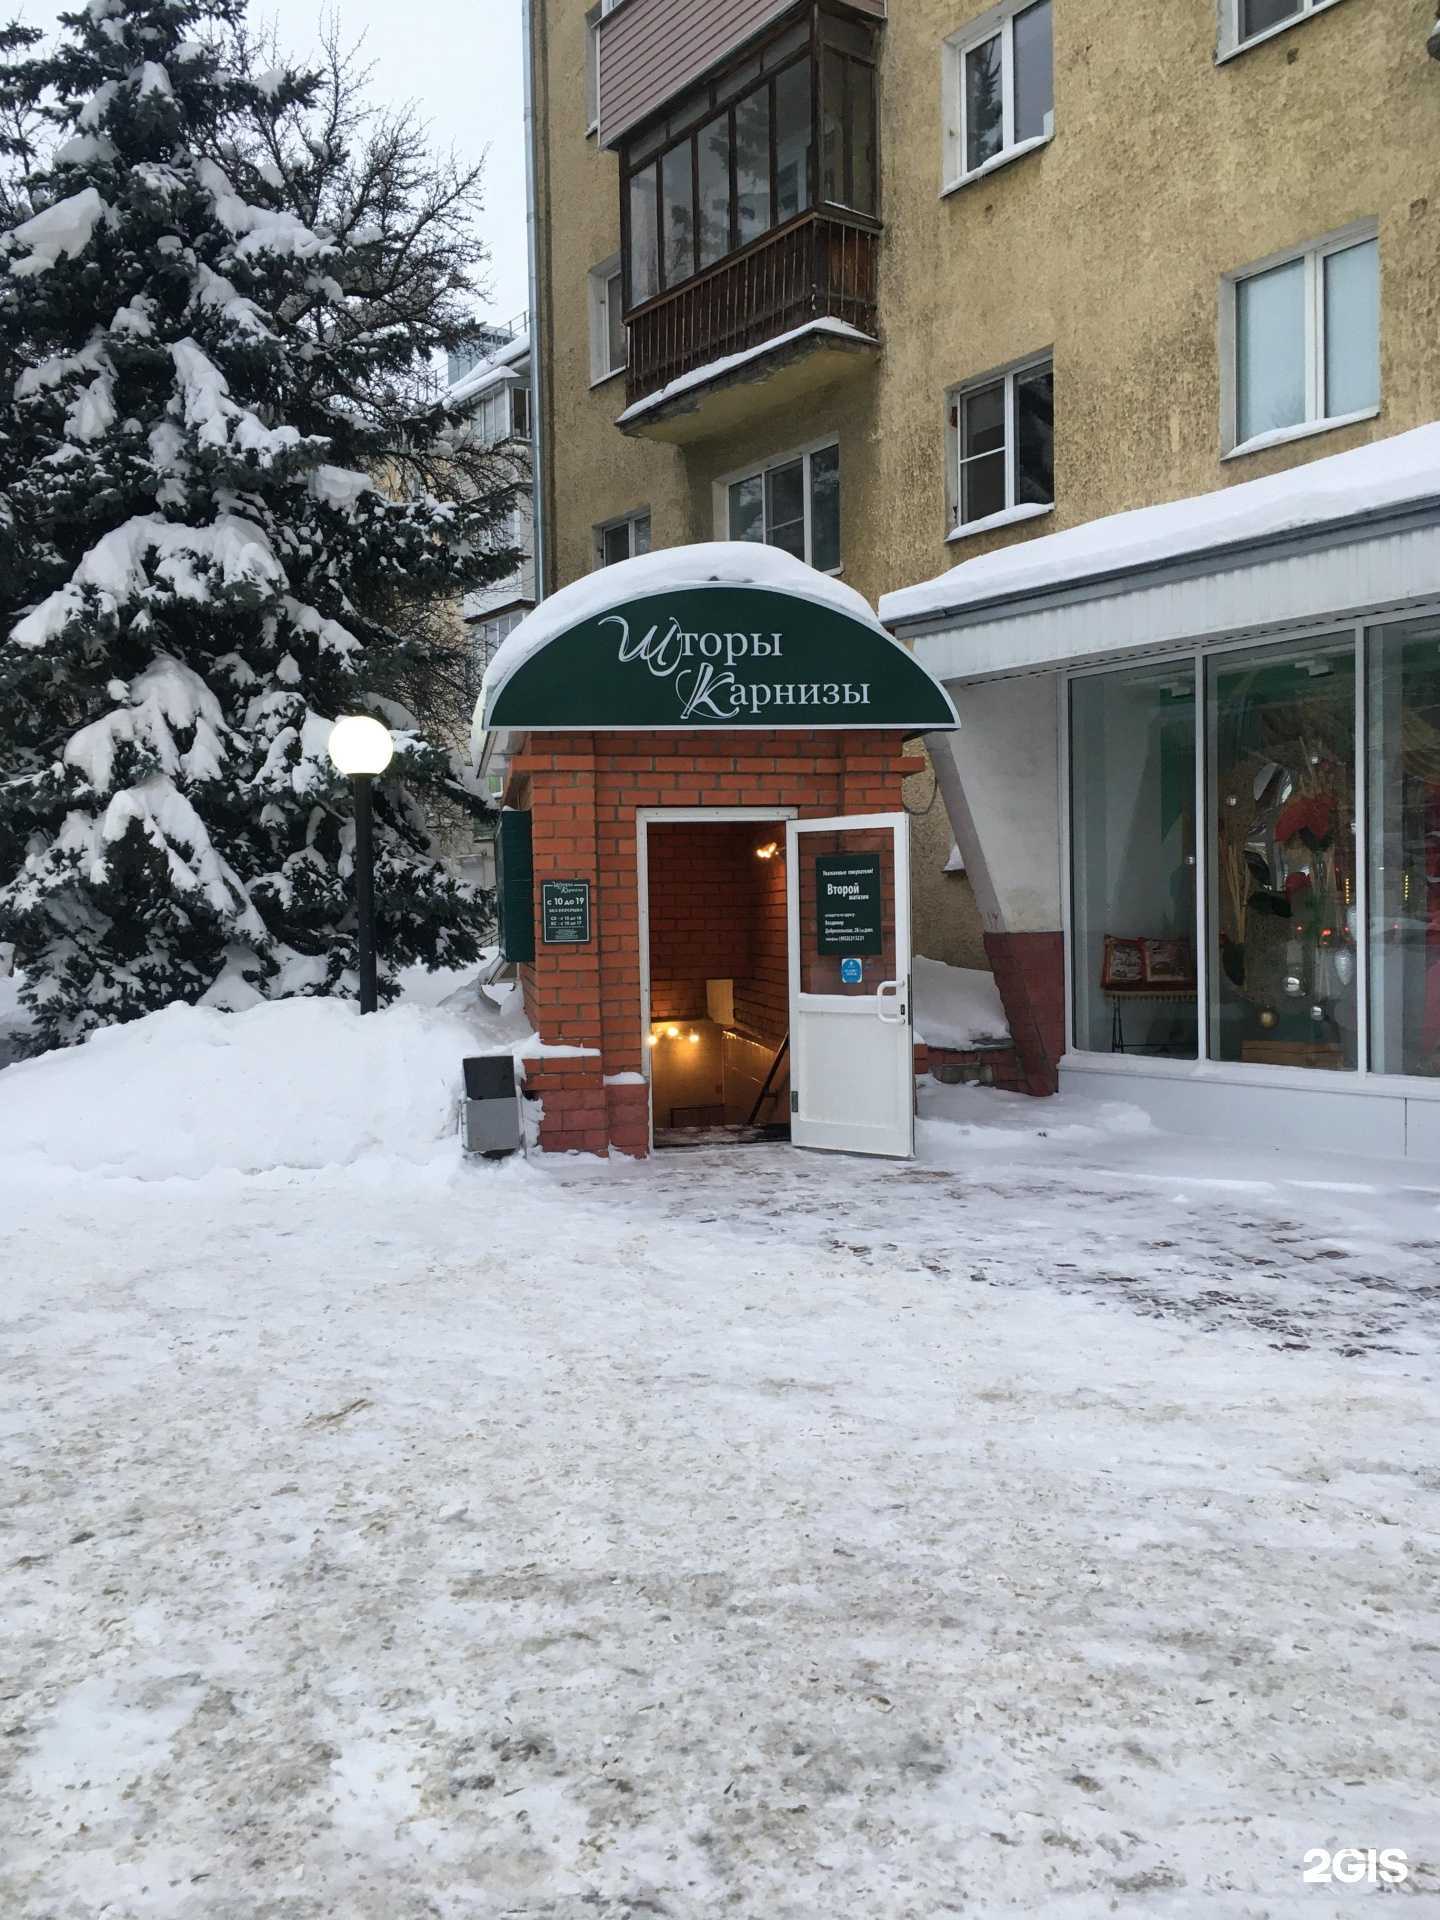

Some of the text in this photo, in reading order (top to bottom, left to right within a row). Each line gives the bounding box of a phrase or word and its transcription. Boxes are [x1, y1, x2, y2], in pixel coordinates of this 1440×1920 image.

[598, 615, 783, 677] Шторы
[675, 662, 871, 720] Карнизы
[554, 897, 563, 906] 10
[576, 897, 585, 905] 19
[827, 882, 860, 897] Второй
